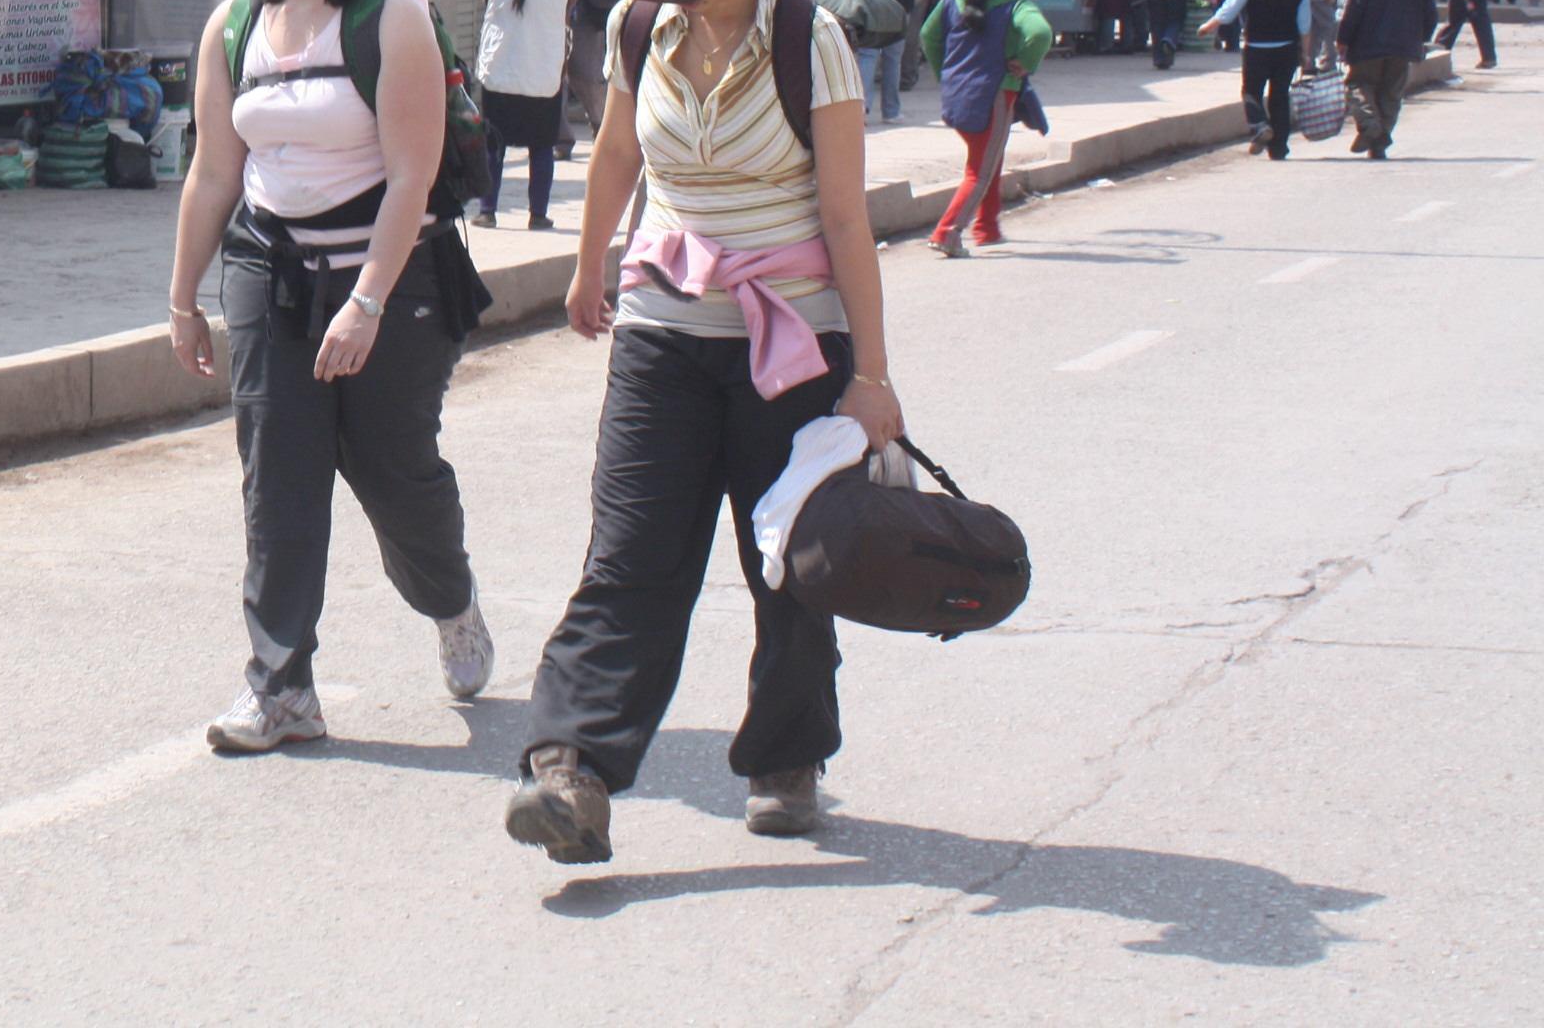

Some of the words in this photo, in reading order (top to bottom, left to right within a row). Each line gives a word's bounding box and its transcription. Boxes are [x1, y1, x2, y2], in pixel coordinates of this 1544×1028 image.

[39, 3, 49, 13] en
[51, 1, 59, 10] el
[28, 13, 68, 25] Vaginales
[26, 27, 64, 38] Urinarios
[4, 43, 15, 52] de
